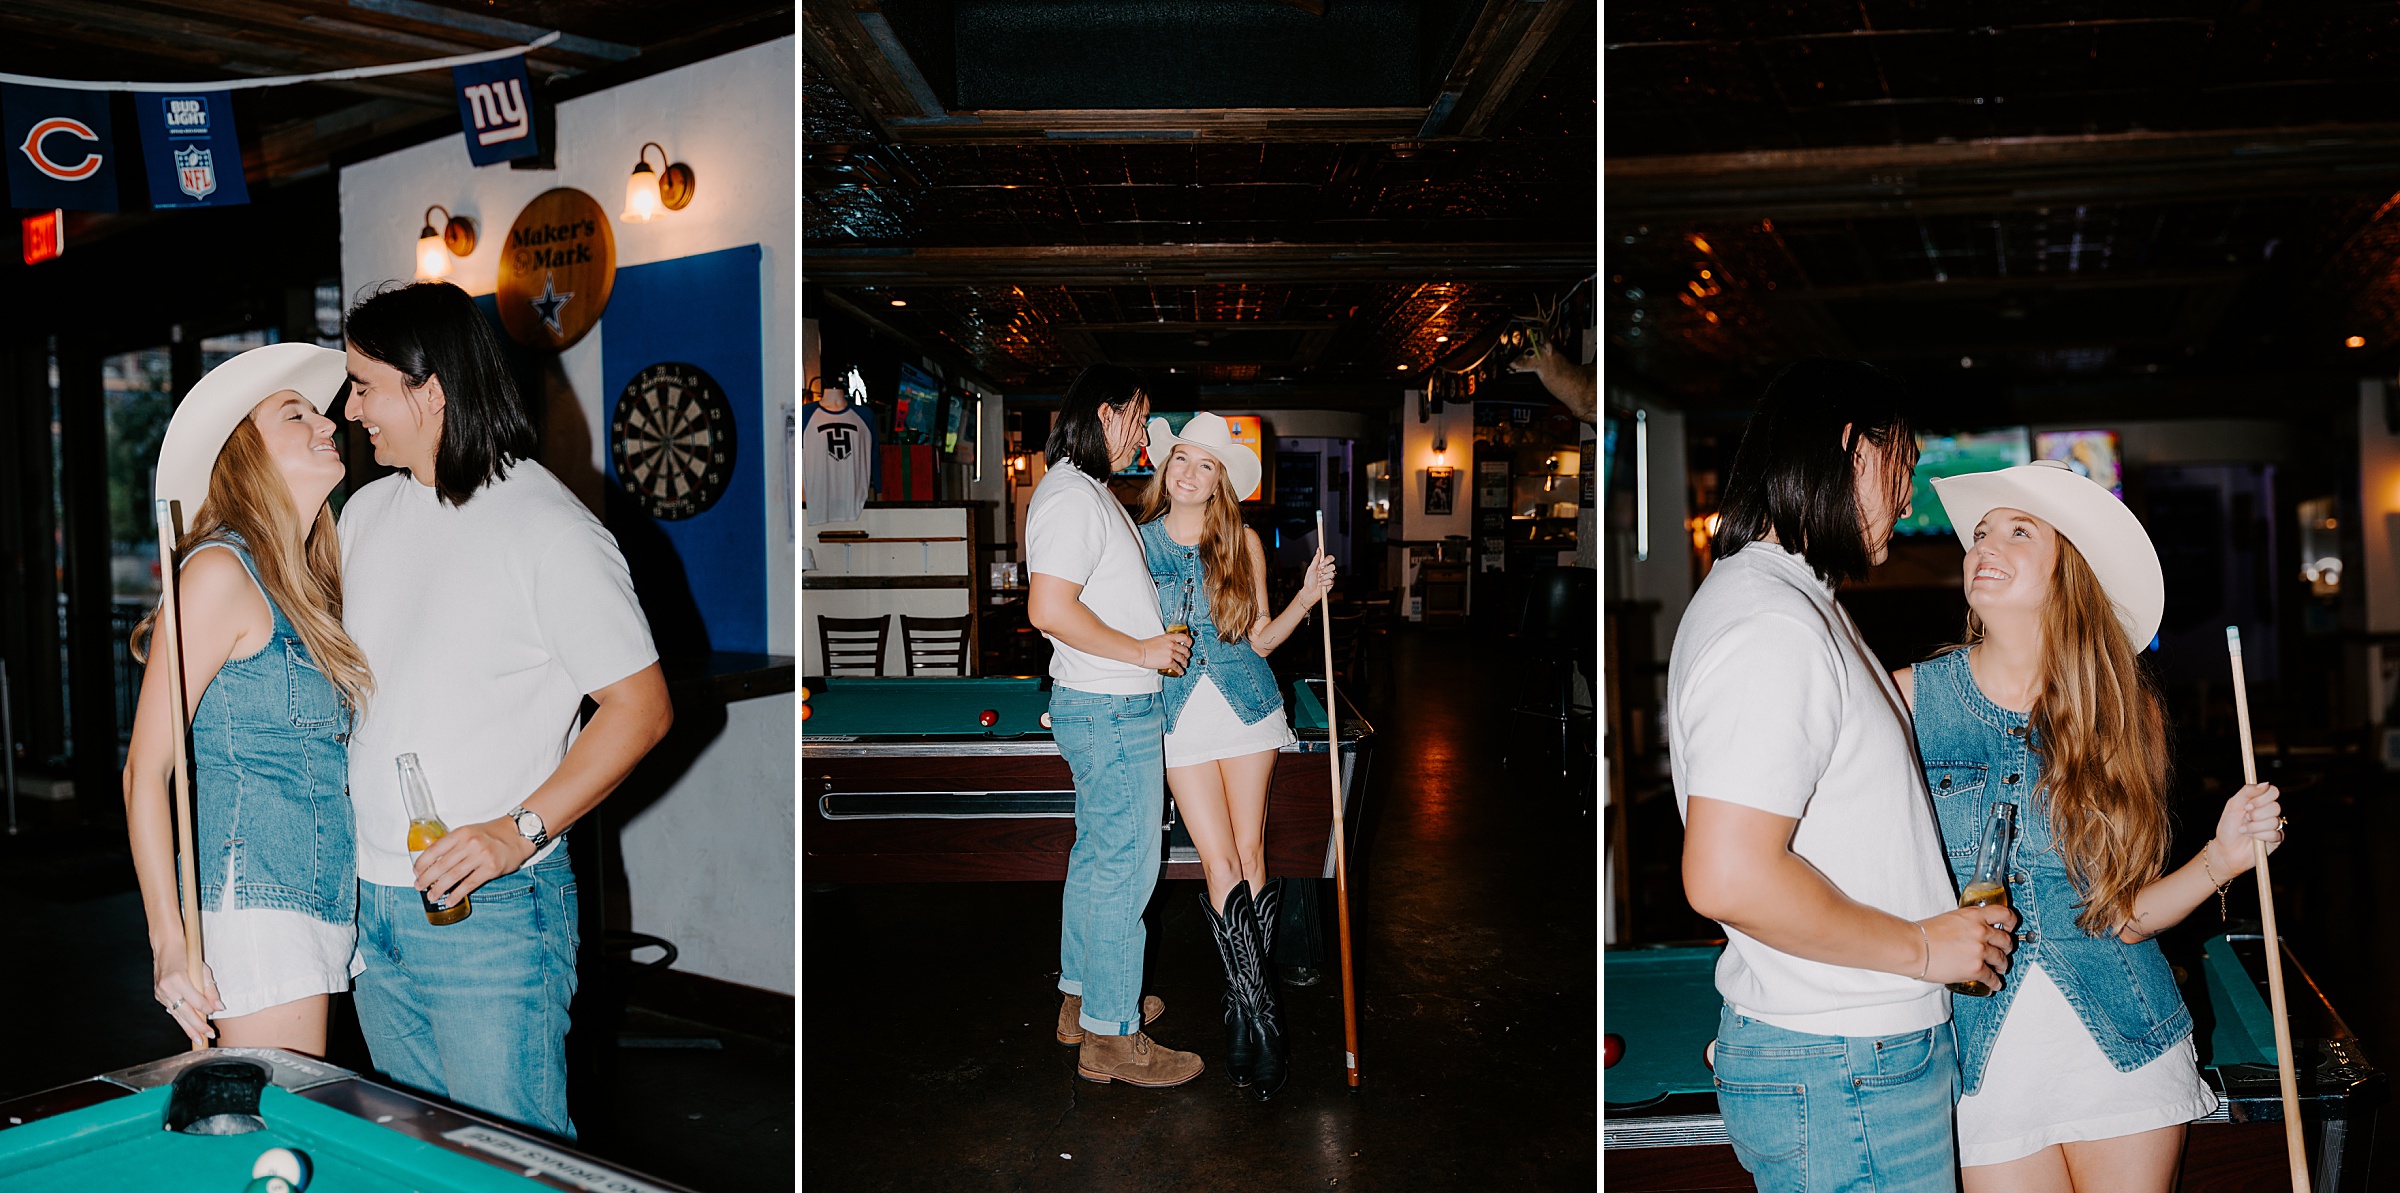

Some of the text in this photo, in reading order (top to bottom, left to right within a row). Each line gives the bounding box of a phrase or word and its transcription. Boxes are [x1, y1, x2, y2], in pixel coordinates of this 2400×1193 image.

[167, 111, 206, 125] LIGHT
[170, 100, 200, 113] BUD
[183, 168, 211, 191] NFL
[512, 219, 595, 249] Maker's
[533, 243, 592, 271] Mark
[469, 1132, 519, 1154] HERE
[523, 1150, 607, 1183] DRINKS
